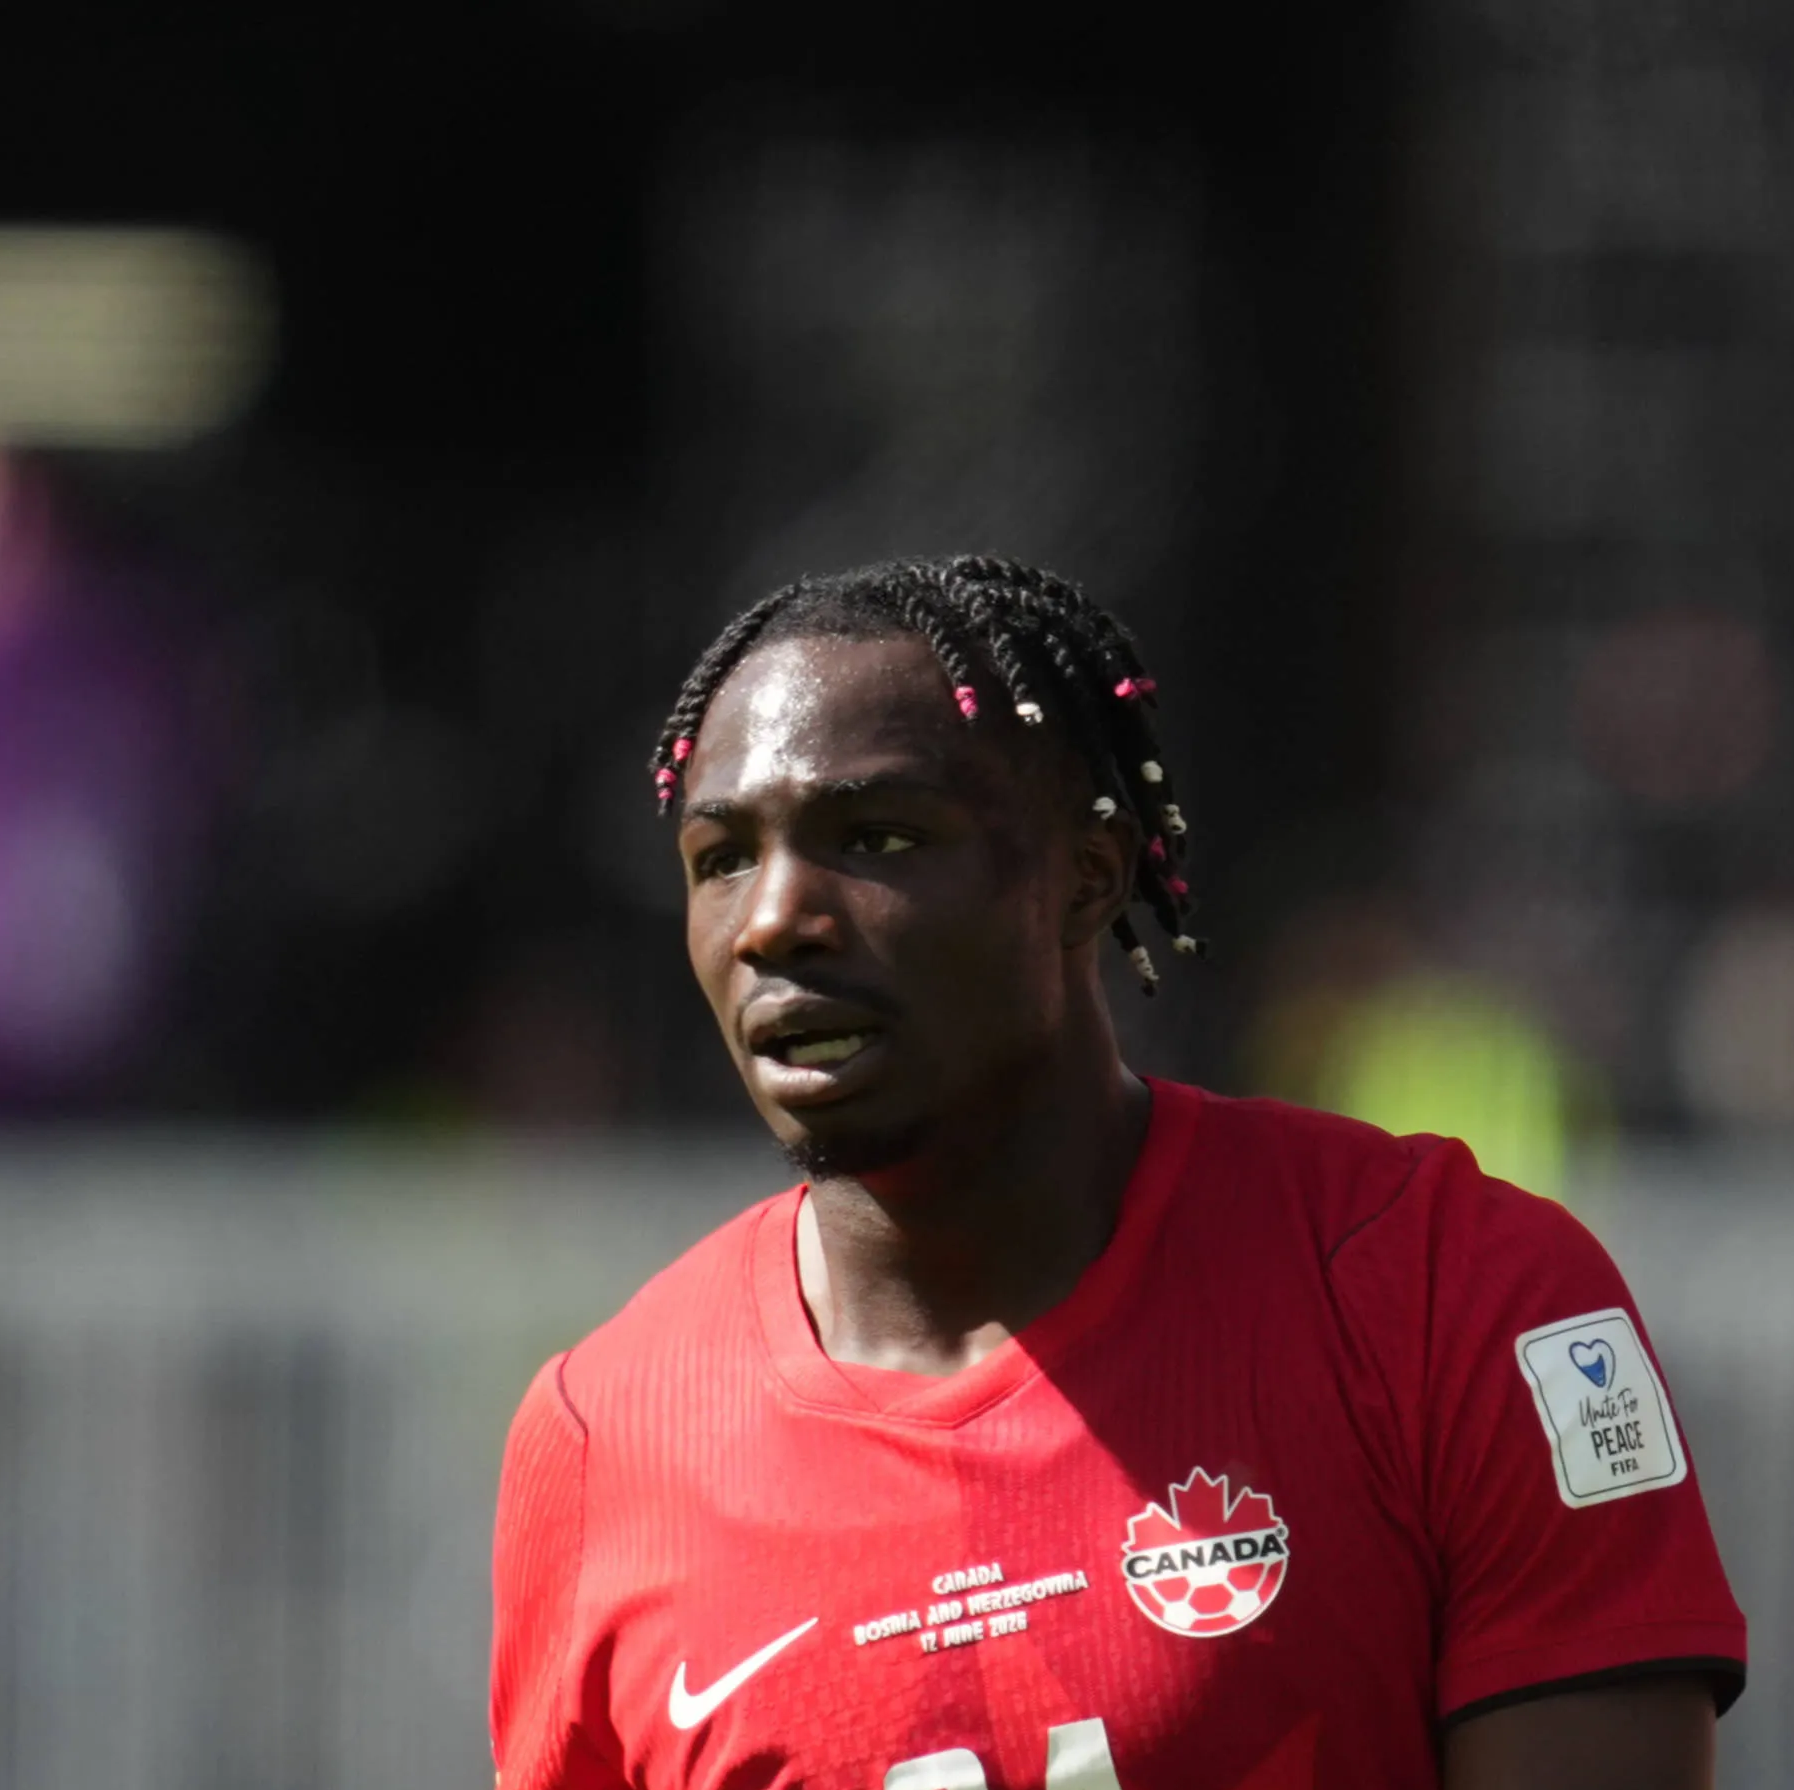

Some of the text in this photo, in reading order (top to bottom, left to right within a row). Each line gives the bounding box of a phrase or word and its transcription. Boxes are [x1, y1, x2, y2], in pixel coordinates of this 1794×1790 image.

[1579, 1395, 1618, 1427] Unite
[1591, 1422, 1644, 1460] PEACE
[1611, 1458, 1639, 1477] FIFA
[1126, 1533, 1284, 1579] CANADA
[932, 1562, 1004, 1594] CANADA
[854, 1570, 1088, 1646] BOSNIA AND HERZEGOVINA
[920, 1611, 1028, 1653] 12 JUNE 2026
